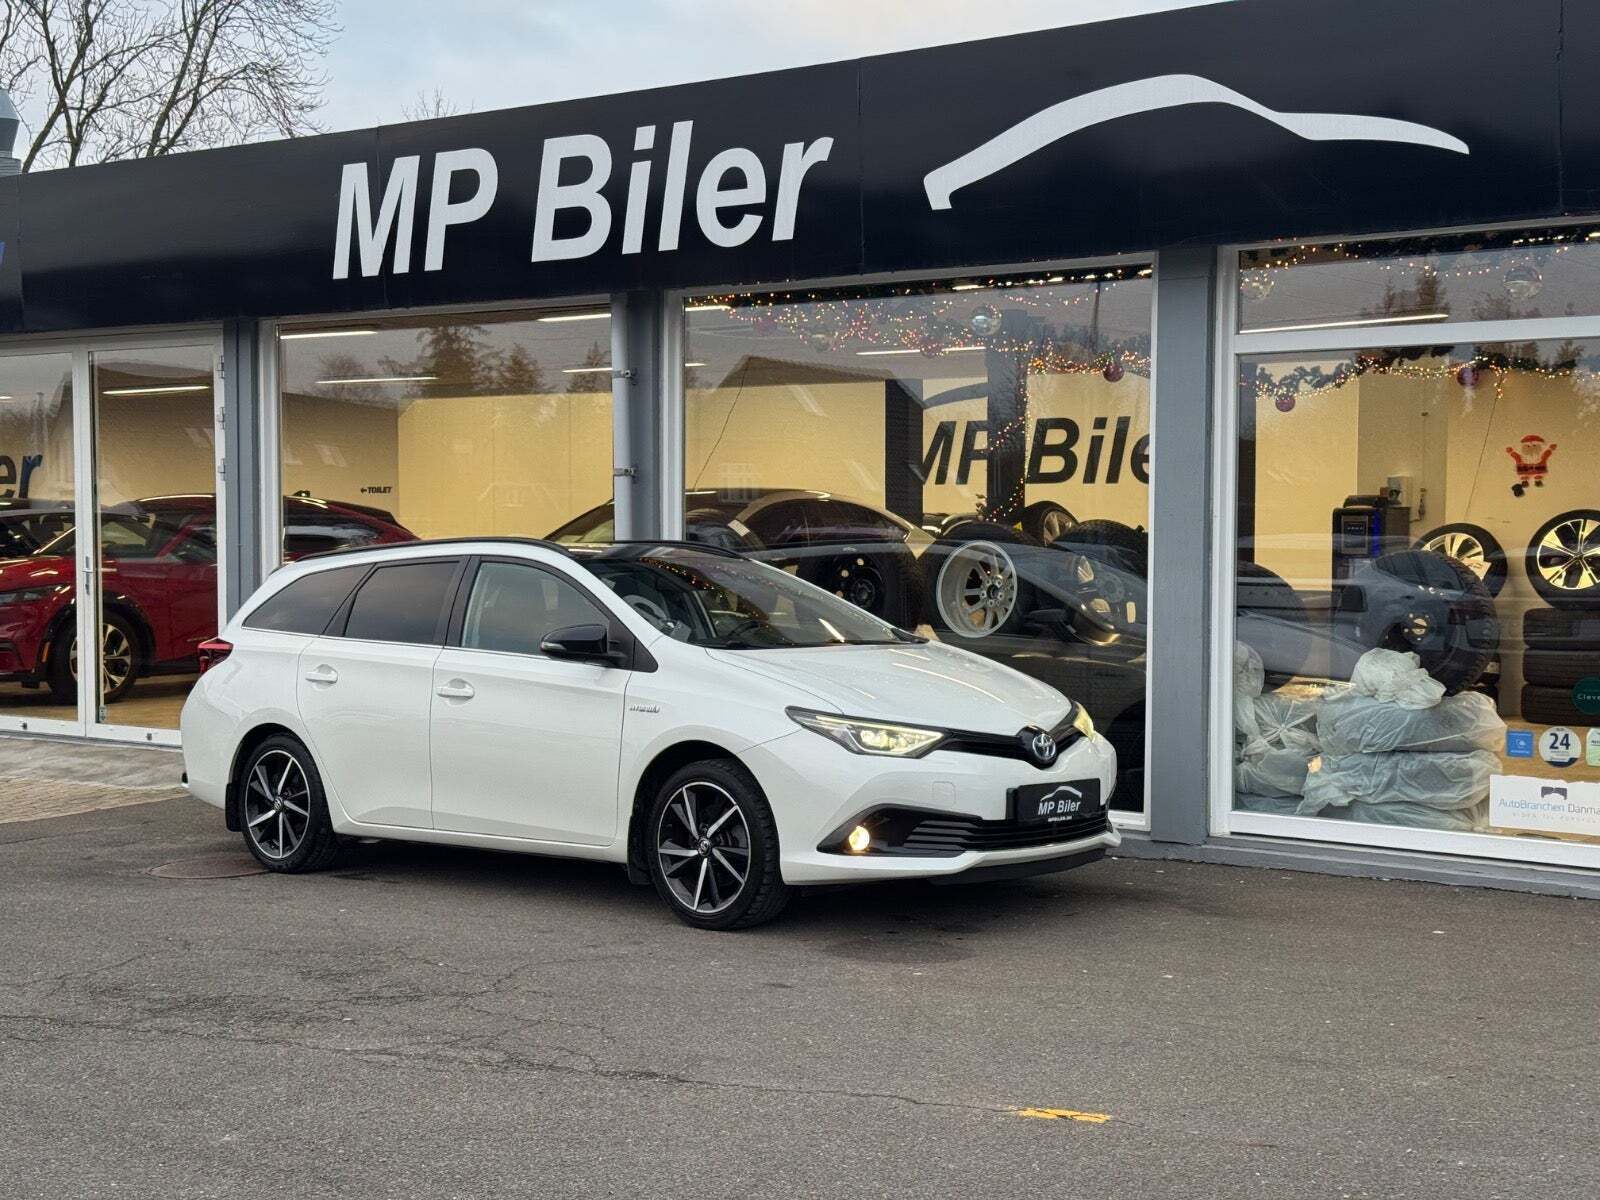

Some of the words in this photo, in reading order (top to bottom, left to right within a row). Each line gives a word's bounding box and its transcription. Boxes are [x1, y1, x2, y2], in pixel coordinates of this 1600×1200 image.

[332, 147, 498, 280] MP
[531, 120, 834, 262] Biler
[367, 486, 392, 494] TOILET
[1549, 733, 1570, 750] 24
[1038, 801, 1055, 815] MP
[1057, 800, 1081, 813] Biler
